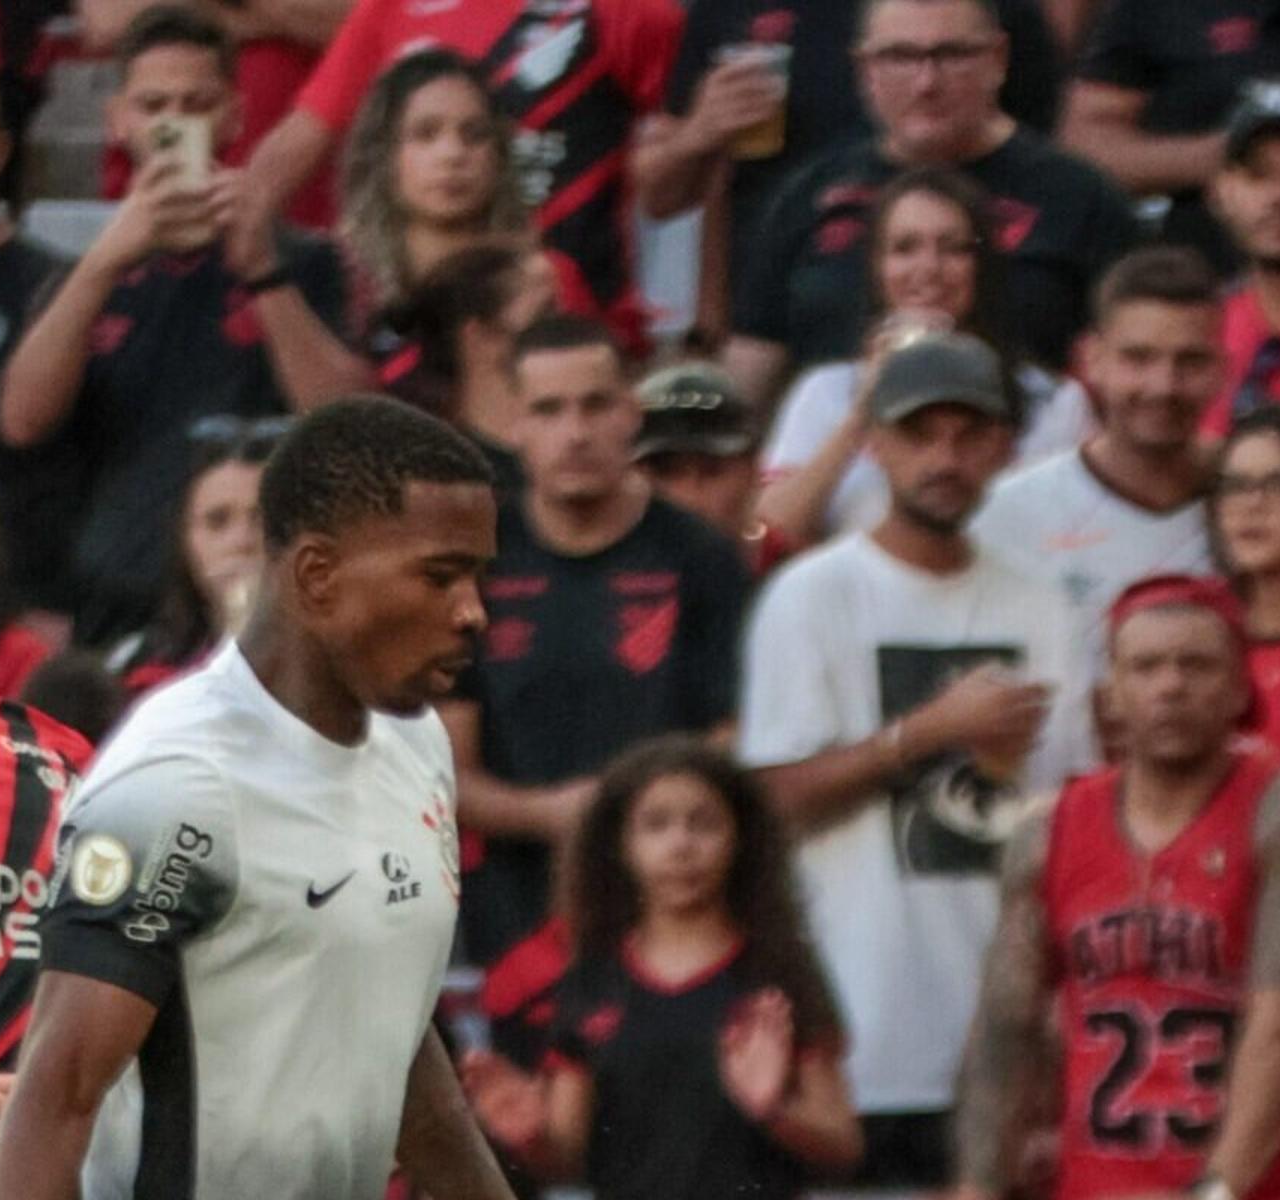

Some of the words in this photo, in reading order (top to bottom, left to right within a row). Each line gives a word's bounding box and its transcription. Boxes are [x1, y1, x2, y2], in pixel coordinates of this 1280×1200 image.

[134, 821, 214, 913] bmg
[384, 882, 422, 906] ALE
[1083, 1004, 1238, 1144] 23
